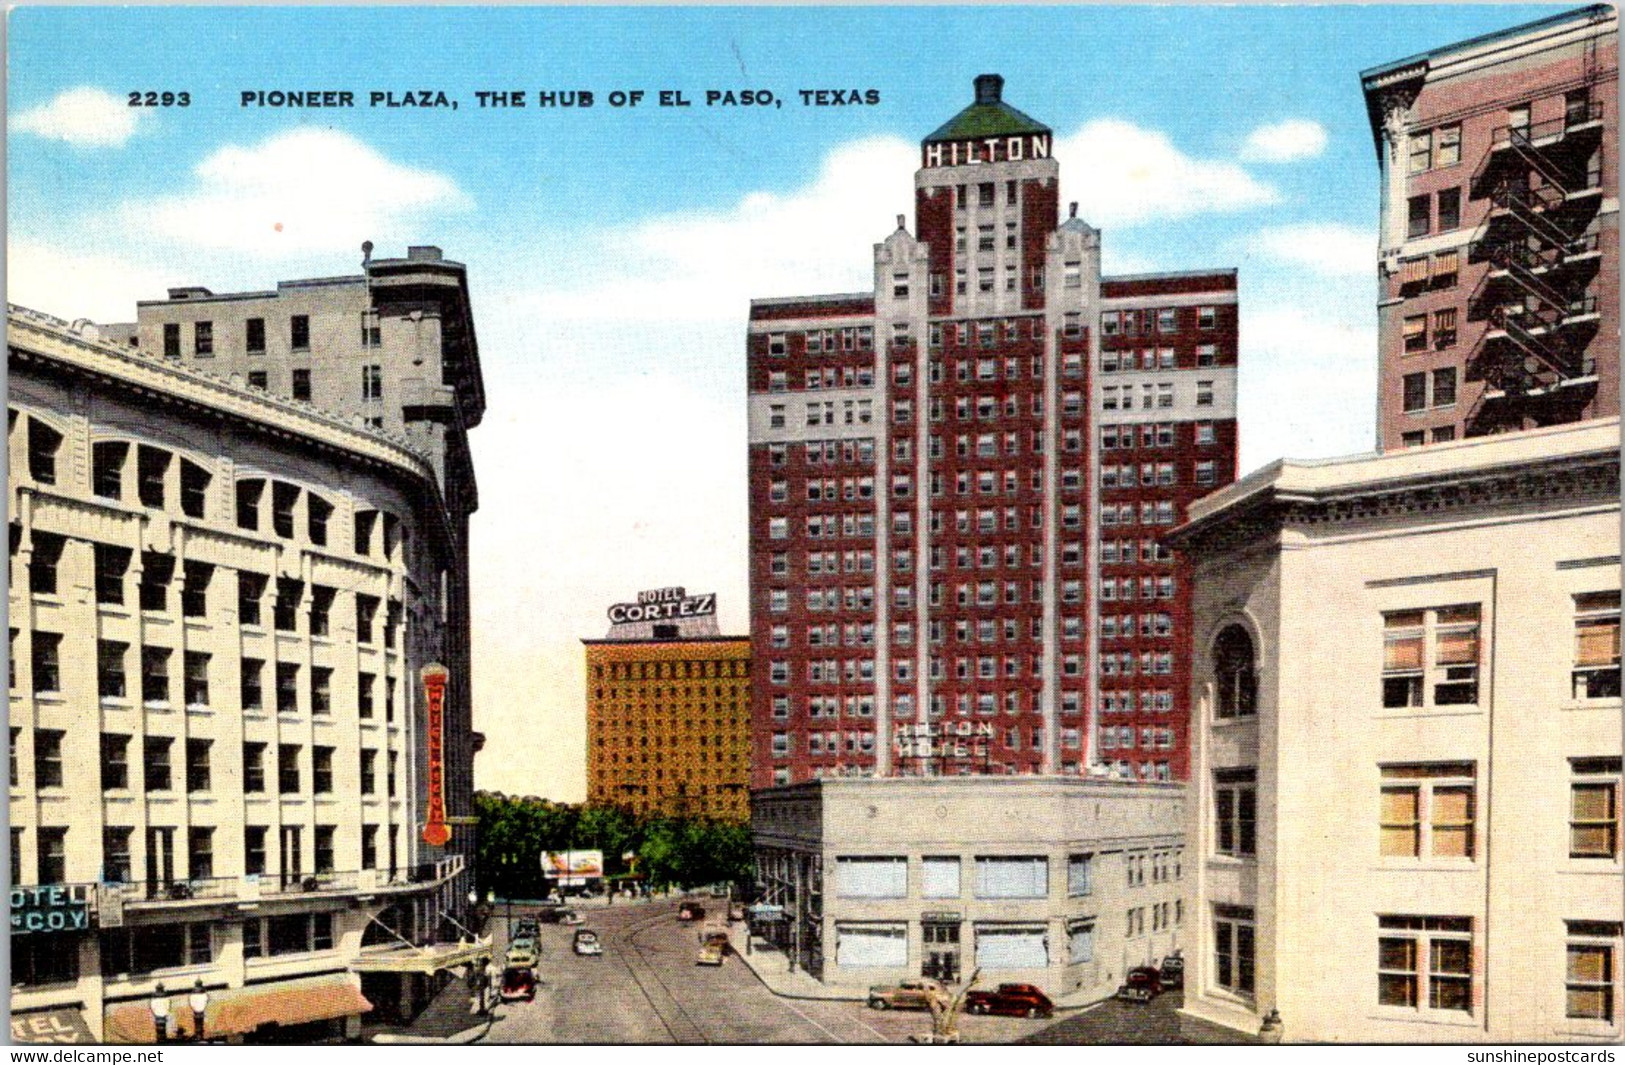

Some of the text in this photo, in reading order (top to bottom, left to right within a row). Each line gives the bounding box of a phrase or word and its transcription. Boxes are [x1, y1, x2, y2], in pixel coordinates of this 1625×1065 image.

[926, 134, 1048, 168] HILTON
[638, 586, 683, 604] HOTEL
[608, 595, 713, 622] CORTEZ
[893, 721, 996, 739] HILTON
